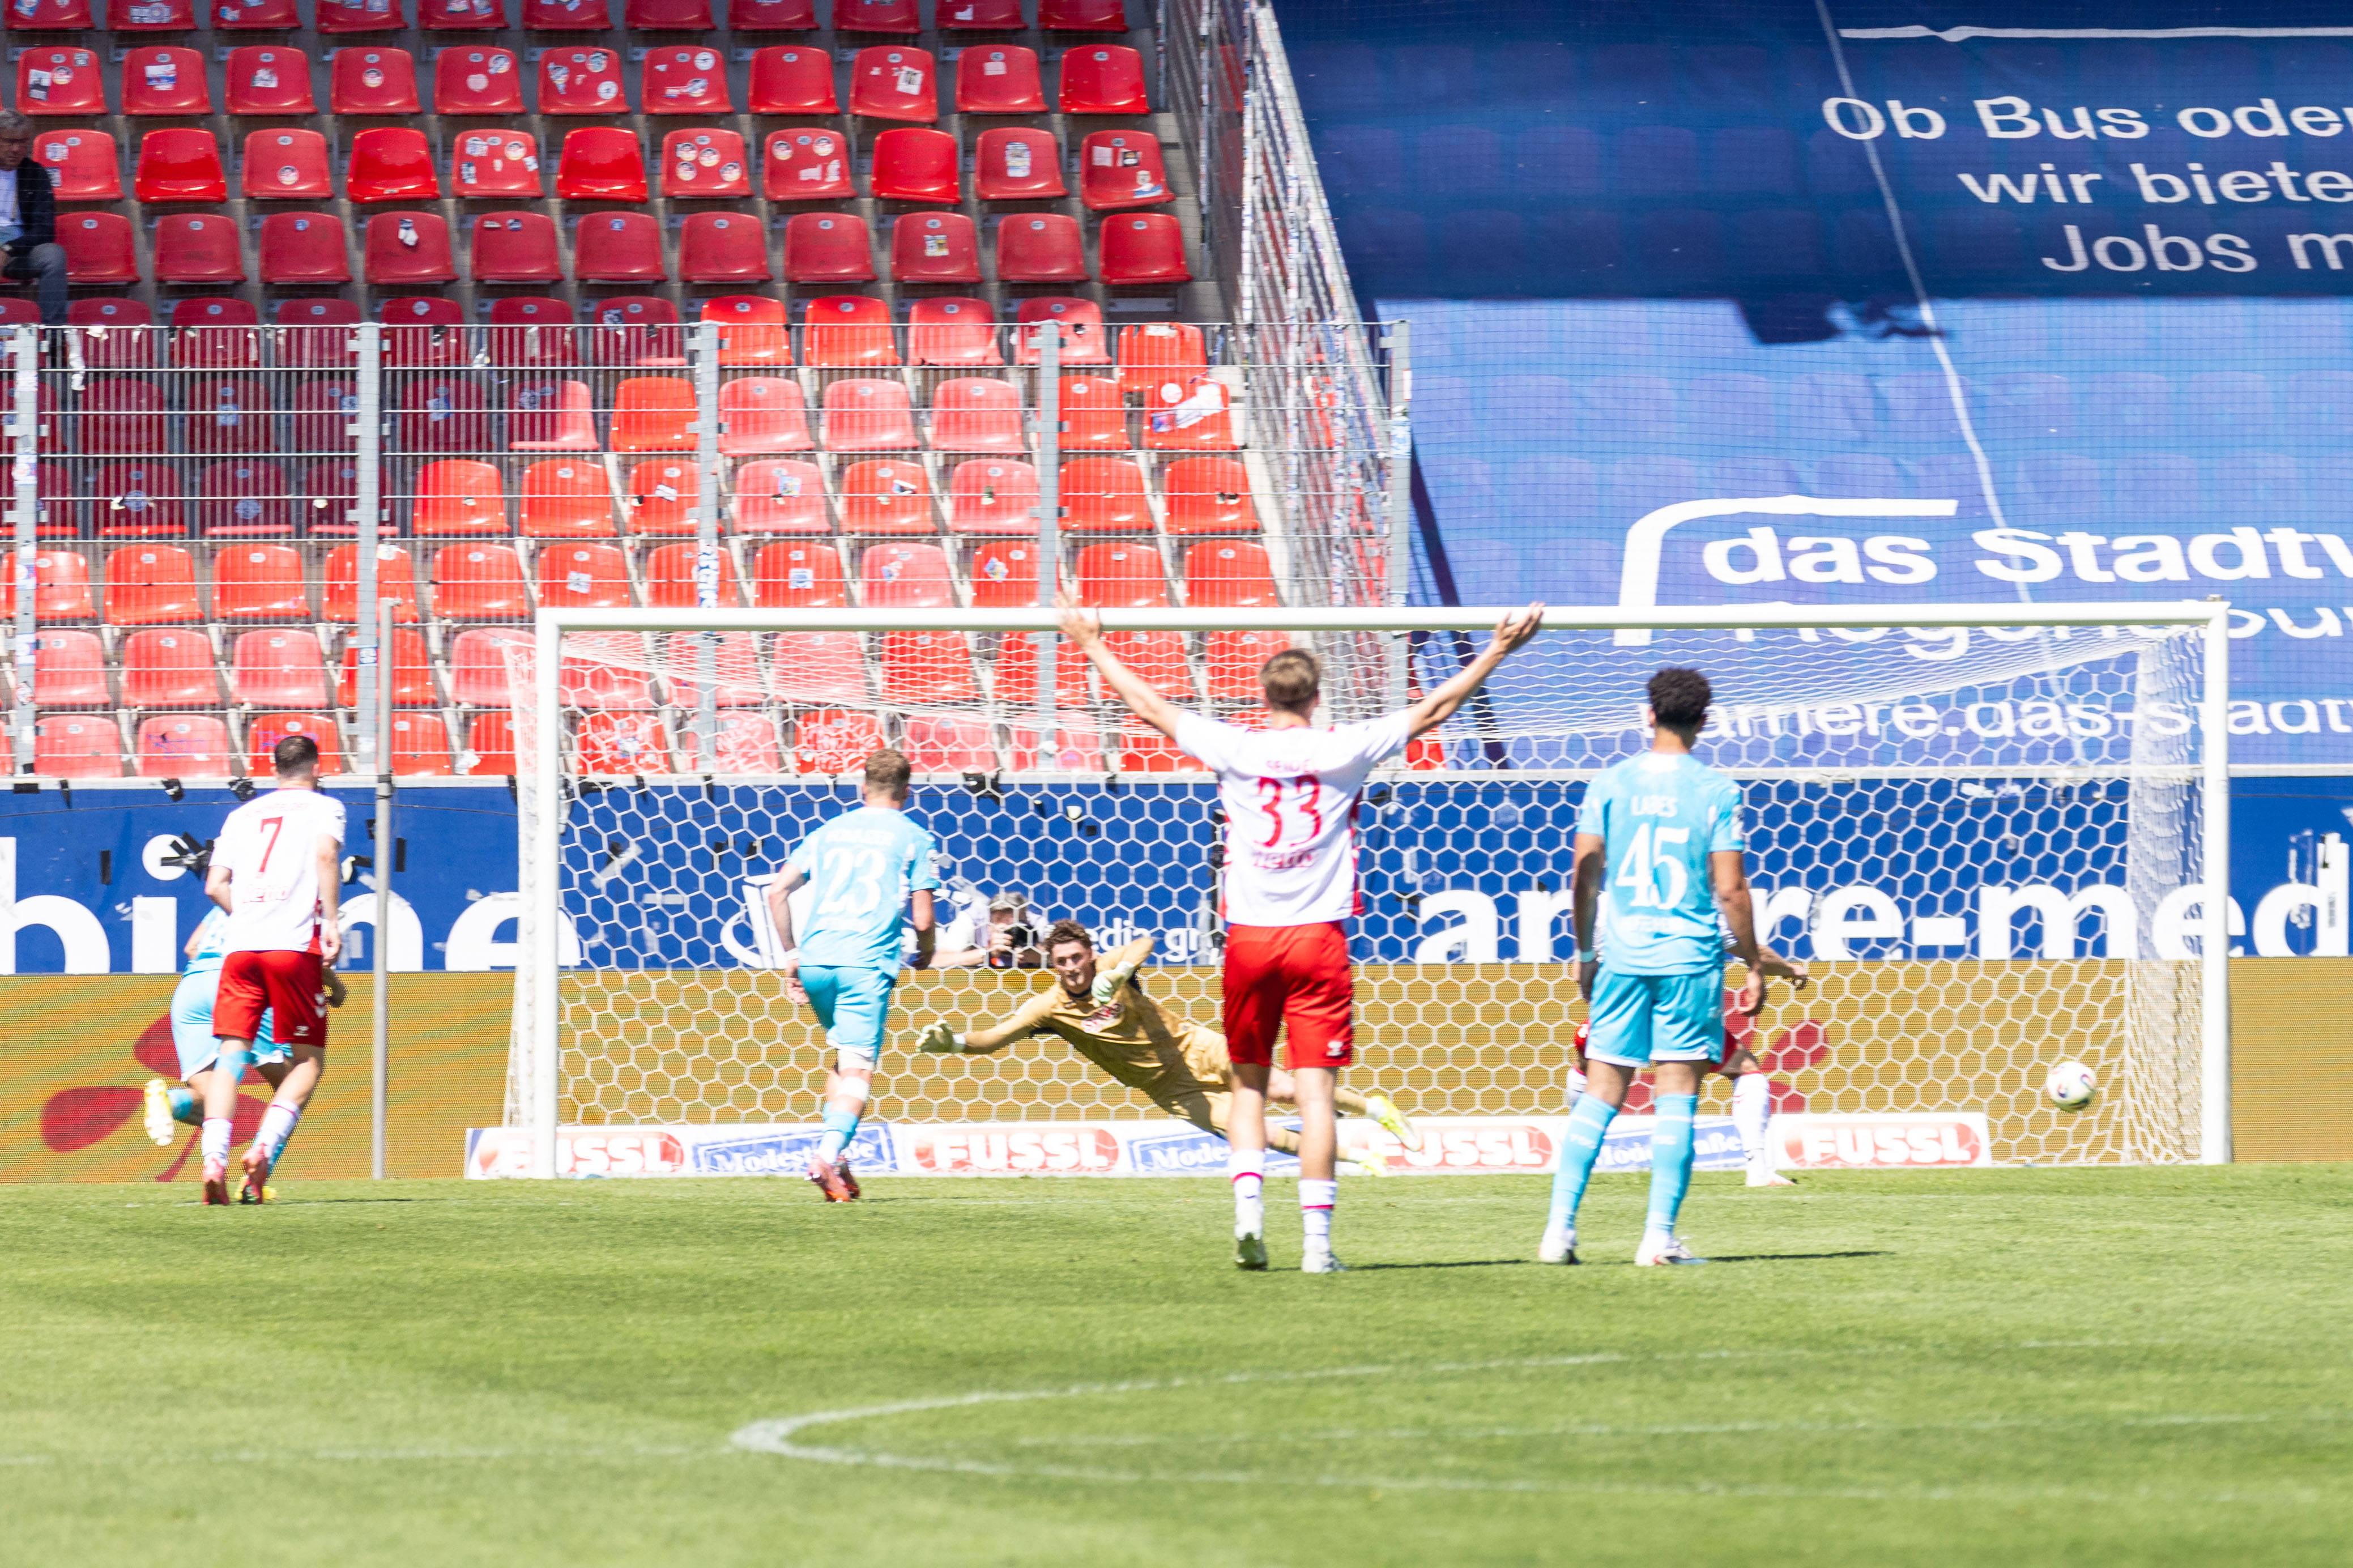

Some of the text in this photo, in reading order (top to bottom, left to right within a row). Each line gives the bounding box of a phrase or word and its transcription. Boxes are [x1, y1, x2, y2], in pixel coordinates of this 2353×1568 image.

[1822, 96, 2353, 140] Ob Bus ode
[1958, 162, 2102, 204] wir
[2042, 224, 2258, 272] Jobs
[1703, 526, 1938, 585] das
[1254, 776, 1322, 848] 33
[259, 816, 284, 873] 7
[1615, 822, 1690, 910] 45
[816, 847, 886, 918] 23
[933, 1132, 1109, 1170] FUSSL
[1803, 1127, 1972, 1165] FUSSL
